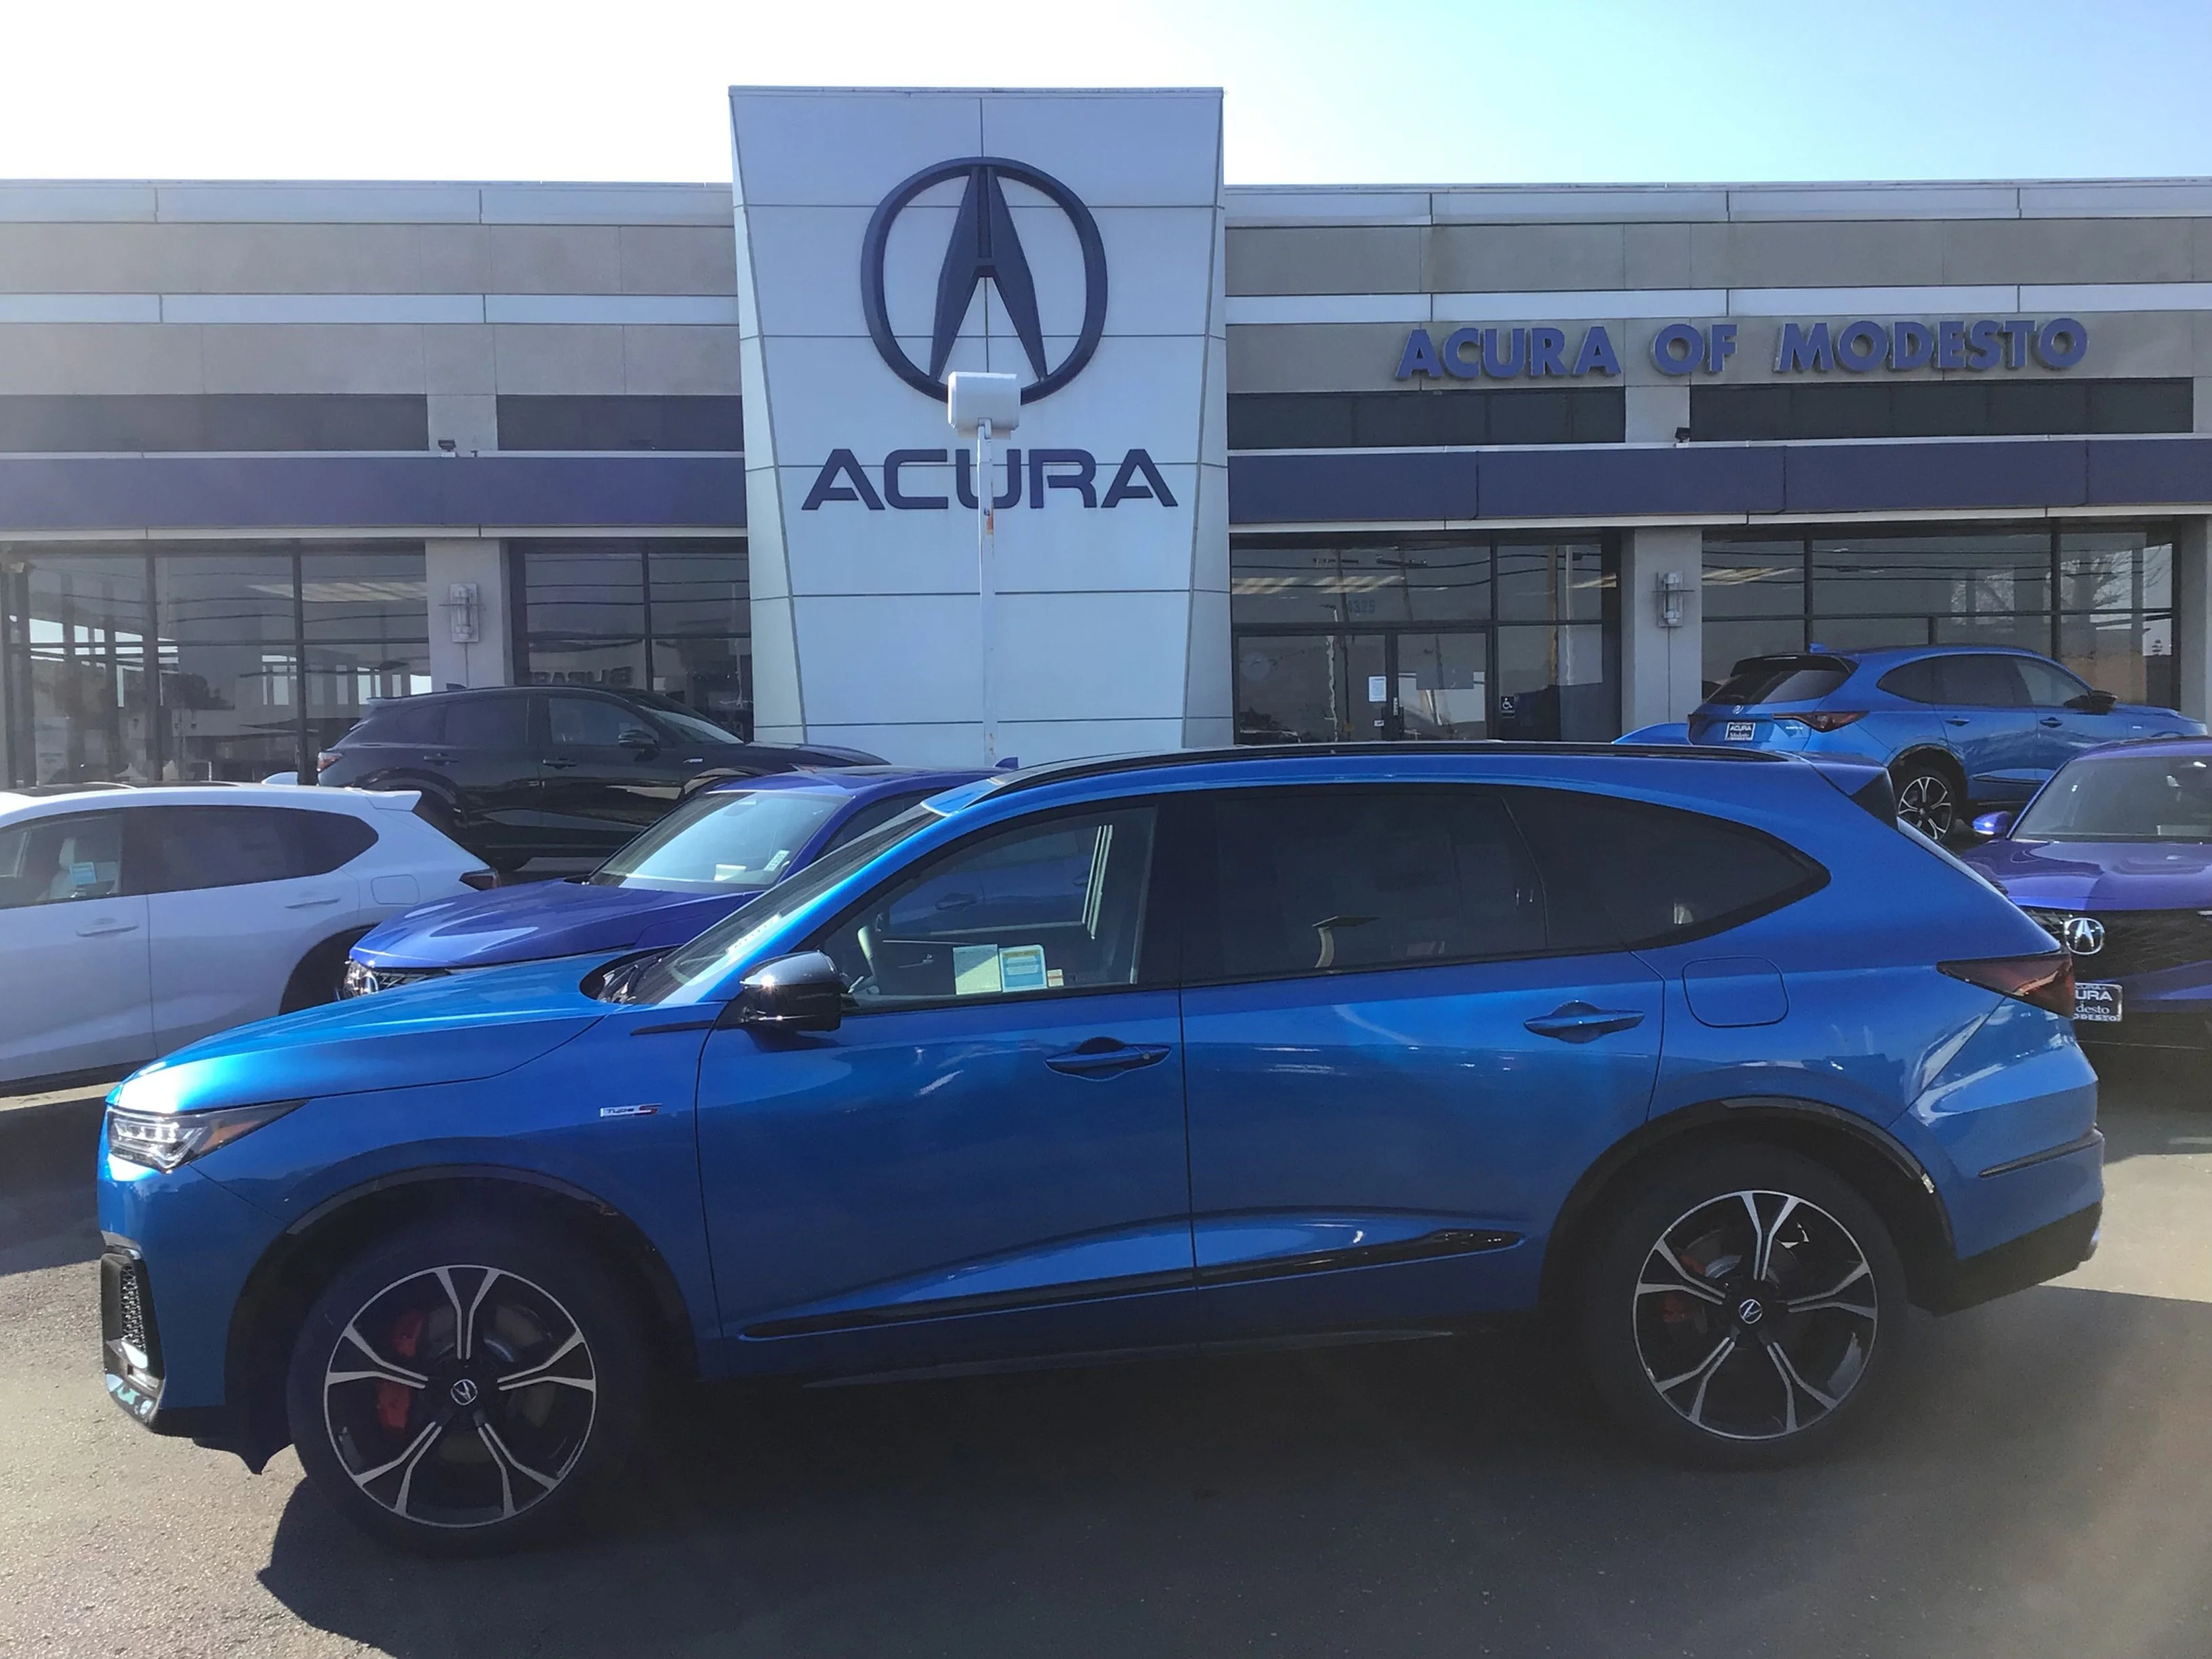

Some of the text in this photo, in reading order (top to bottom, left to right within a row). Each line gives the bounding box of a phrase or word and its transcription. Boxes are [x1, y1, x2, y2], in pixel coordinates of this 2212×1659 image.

[1395, 318, 2089, 380] ACURA OF MODESTO
[802, 449, 1178, 510] ACURA
[2075, 989, 2113, 1001] URA
[2076, 1003, 2110, 1014] desto
